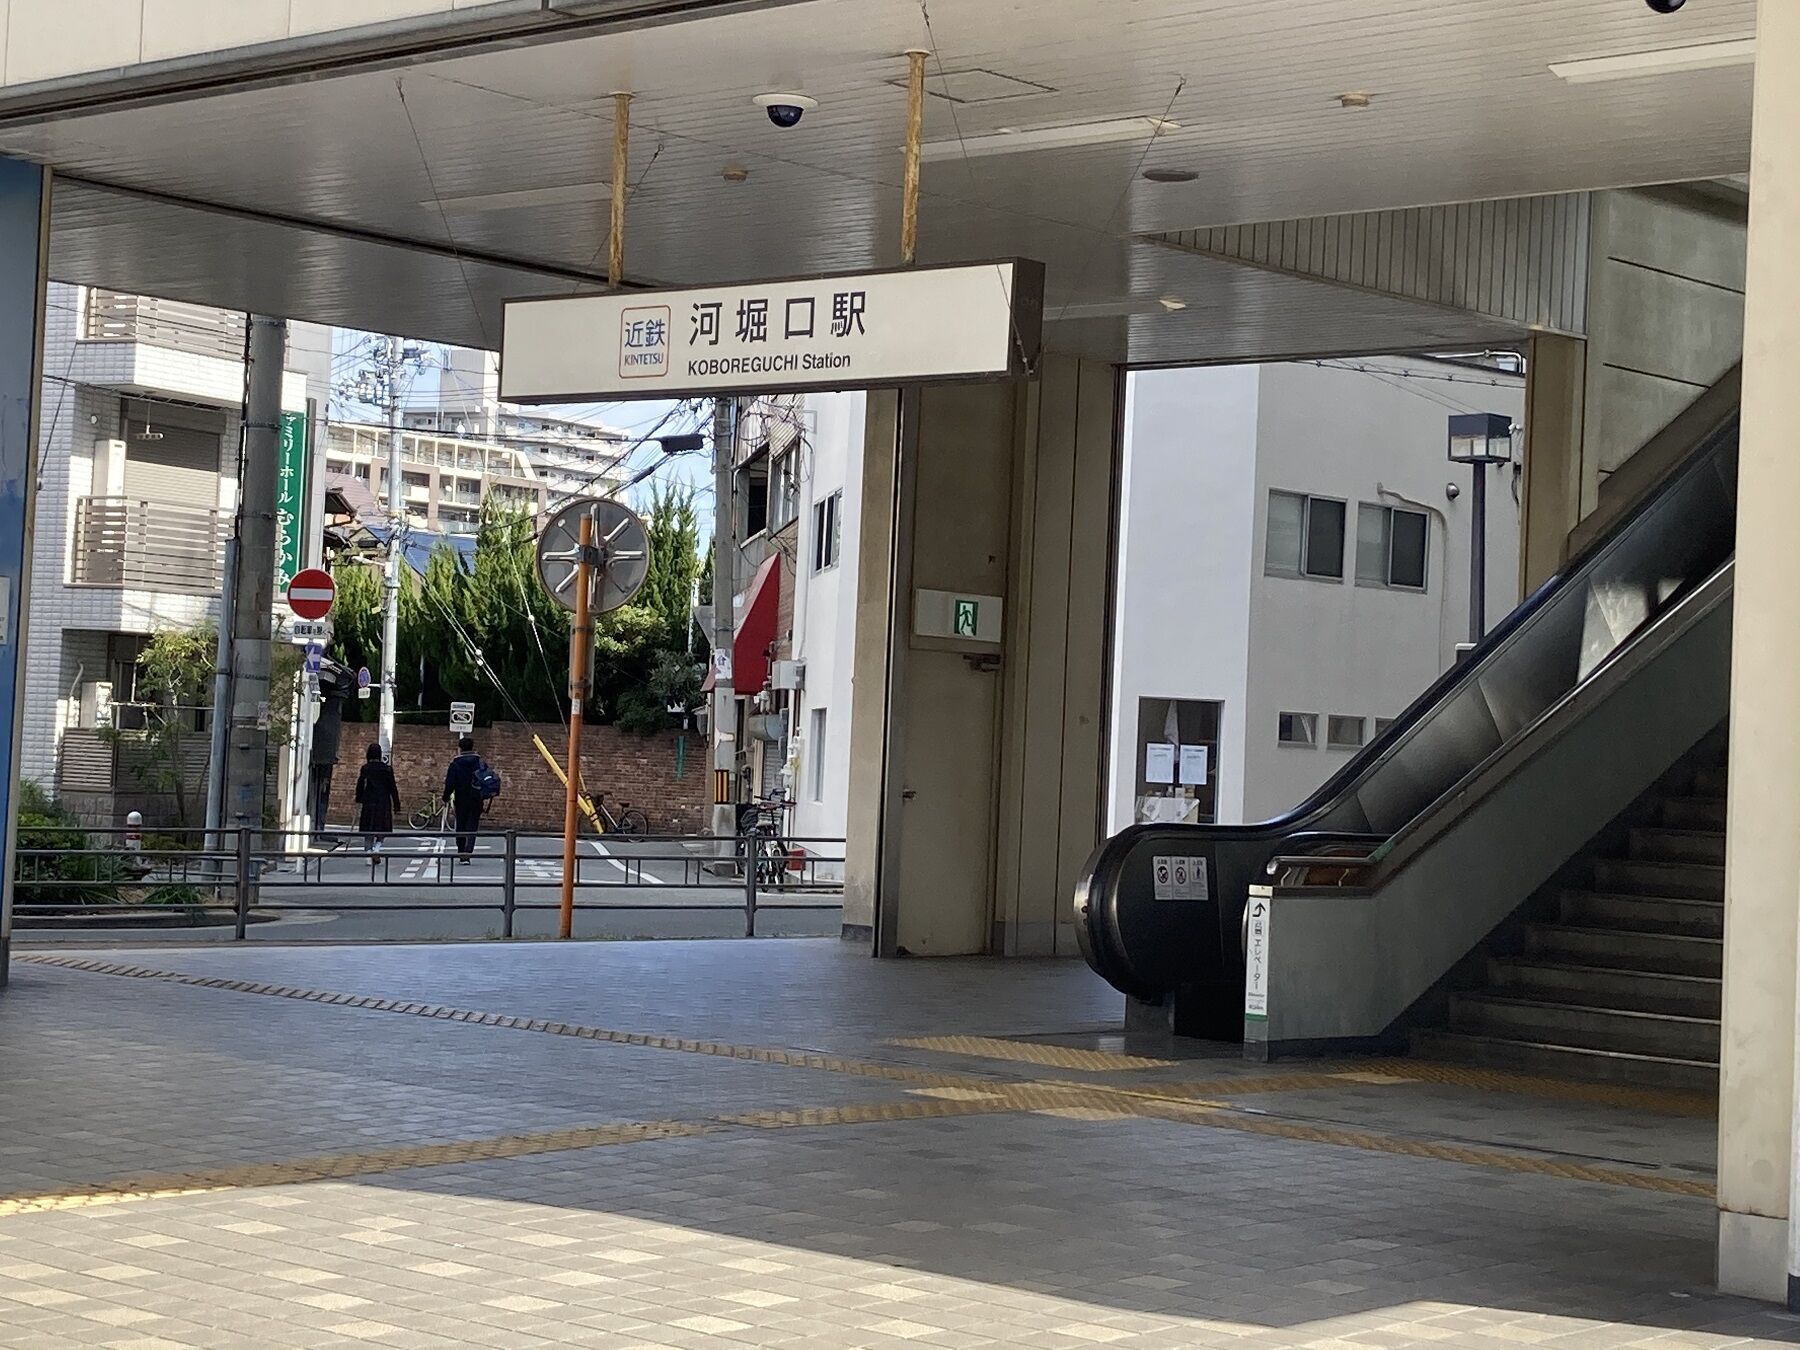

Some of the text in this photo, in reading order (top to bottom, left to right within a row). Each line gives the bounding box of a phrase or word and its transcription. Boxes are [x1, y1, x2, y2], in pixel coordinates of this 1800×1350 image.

[689, 291, 866, 346] 河堀口駅
[624, 318, 666, 347] 近鉄
[624, 352, 664, 366] KINTETSU
[688, 352, 851, 376] KOBOREGUCHI Station
